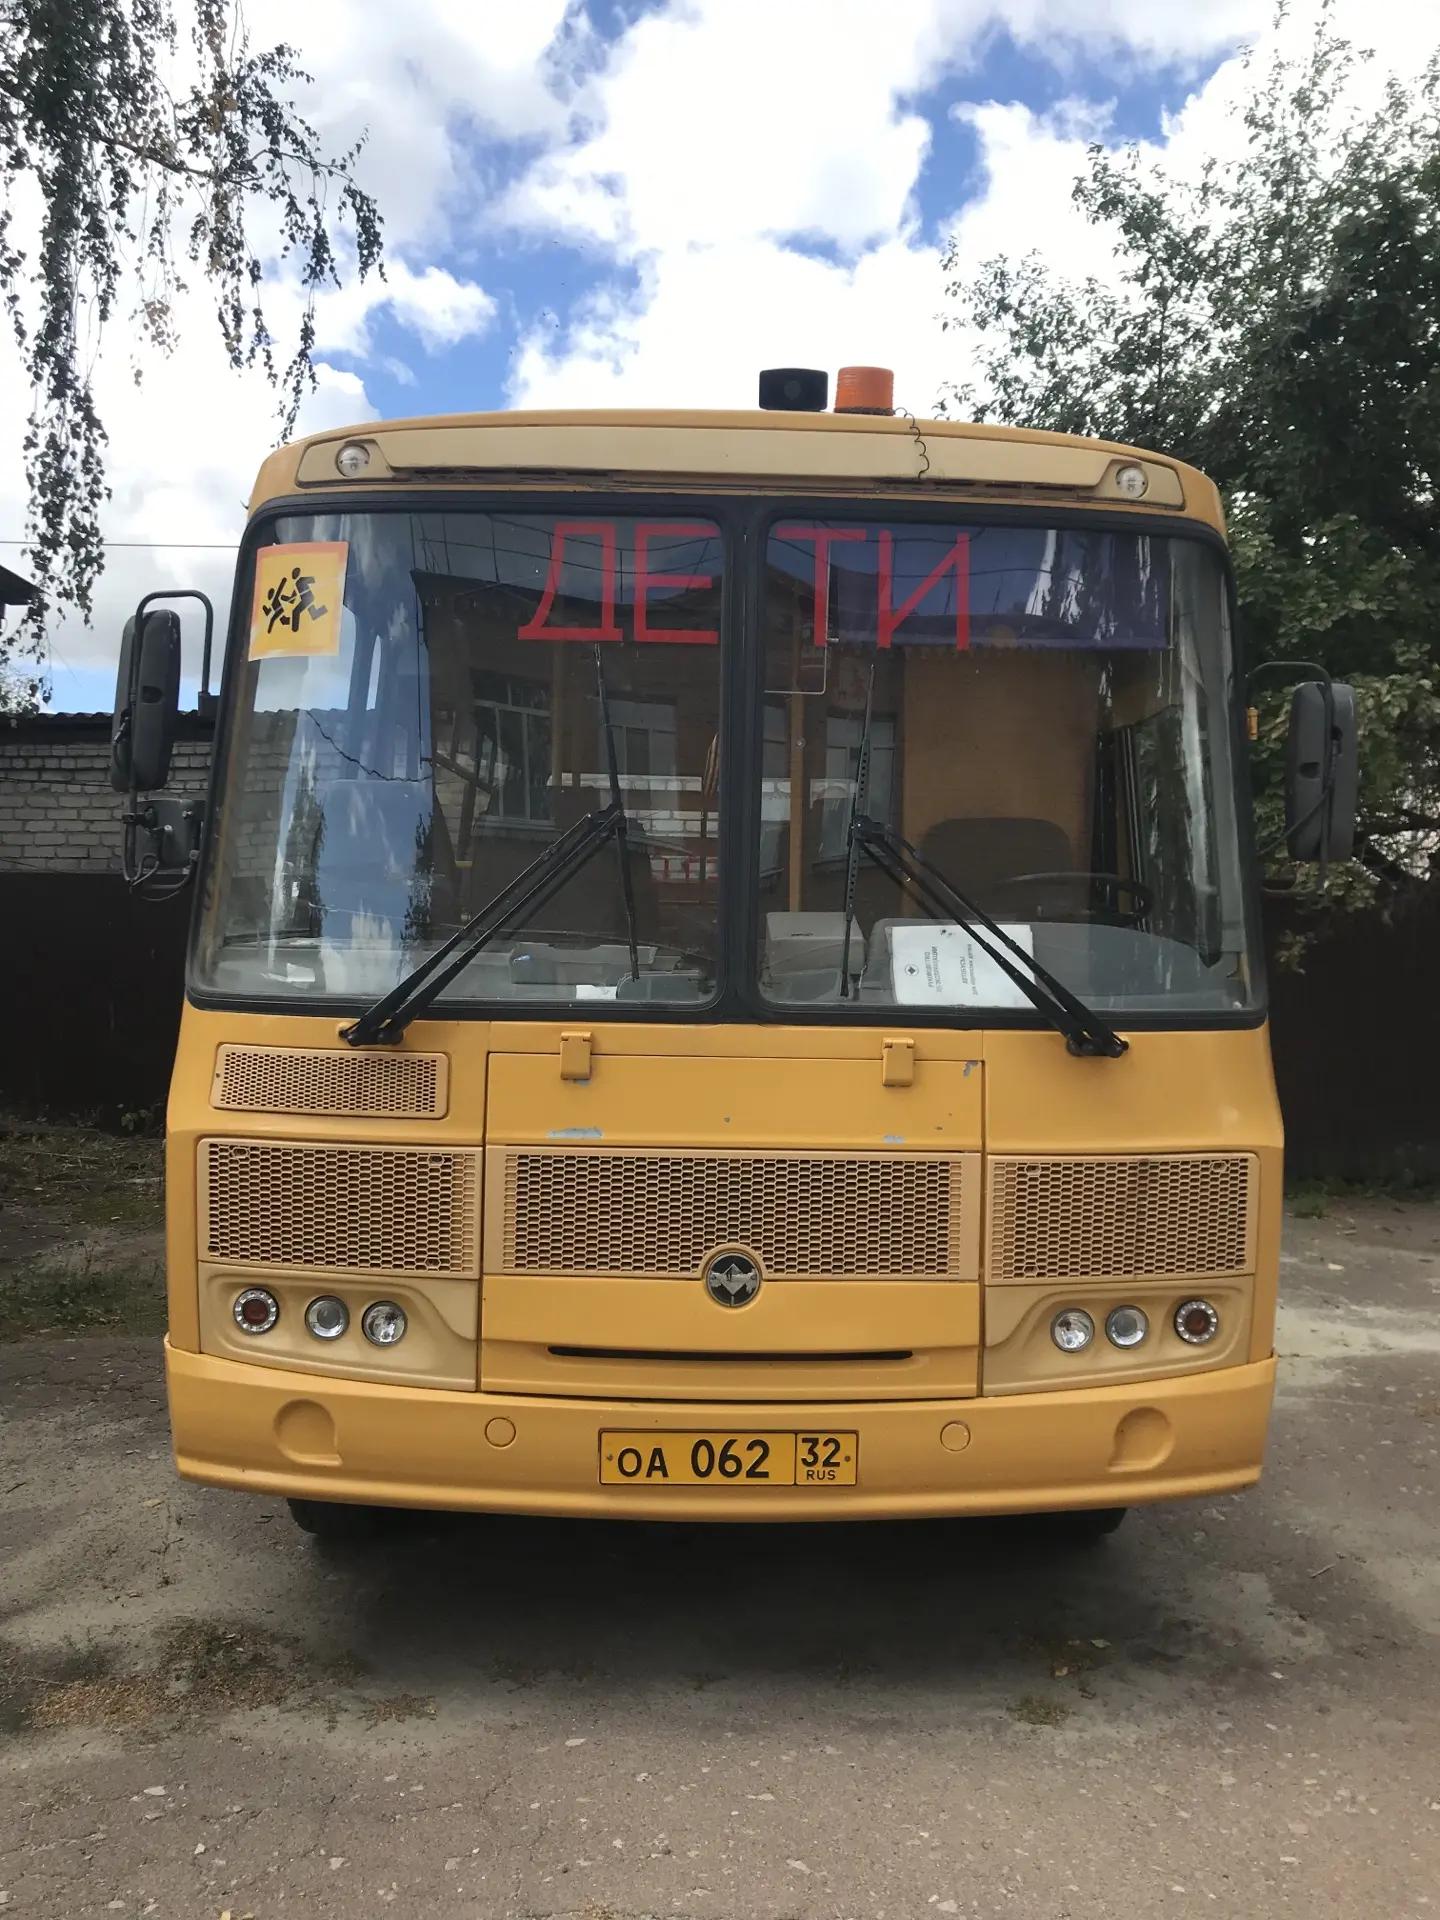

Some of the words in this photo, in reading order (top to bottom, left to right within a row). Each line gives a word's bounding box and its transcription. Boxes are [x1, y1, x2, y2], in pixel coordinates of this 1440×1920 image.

[690, 1438, 770, 1479] 062
[801, 1437, 841, 1468] 32
[806, 1469, 836, 1481] RUS
